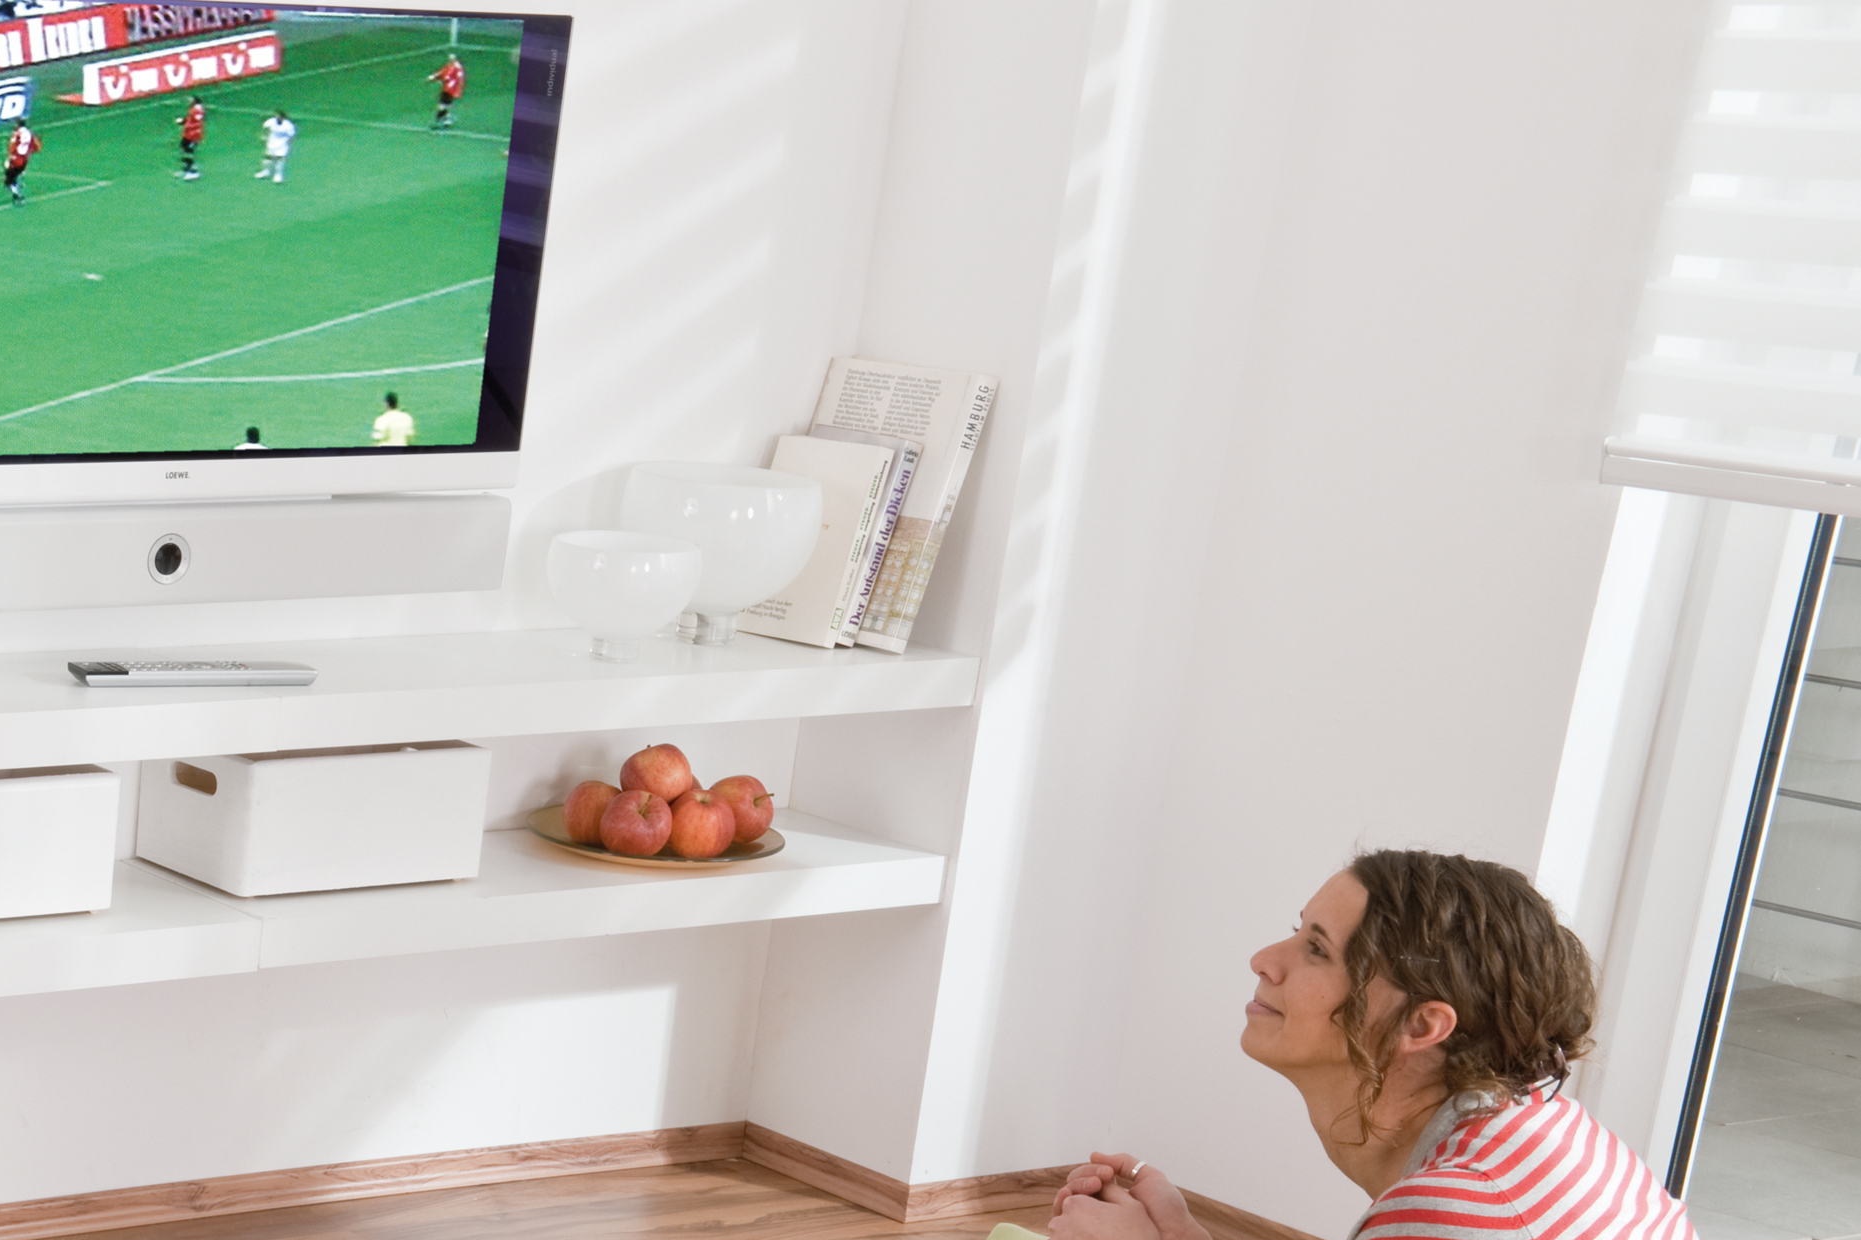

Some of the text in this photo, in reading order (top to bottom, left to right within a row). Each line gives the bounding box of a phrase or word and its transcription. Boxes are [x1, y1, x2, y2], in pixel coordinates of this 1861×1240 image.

[547, 49, 558, 97] individual
[960, 385, 989, 450] HAMBURG
[849, 470, 911, 626] Der Aufstand der Dicken
